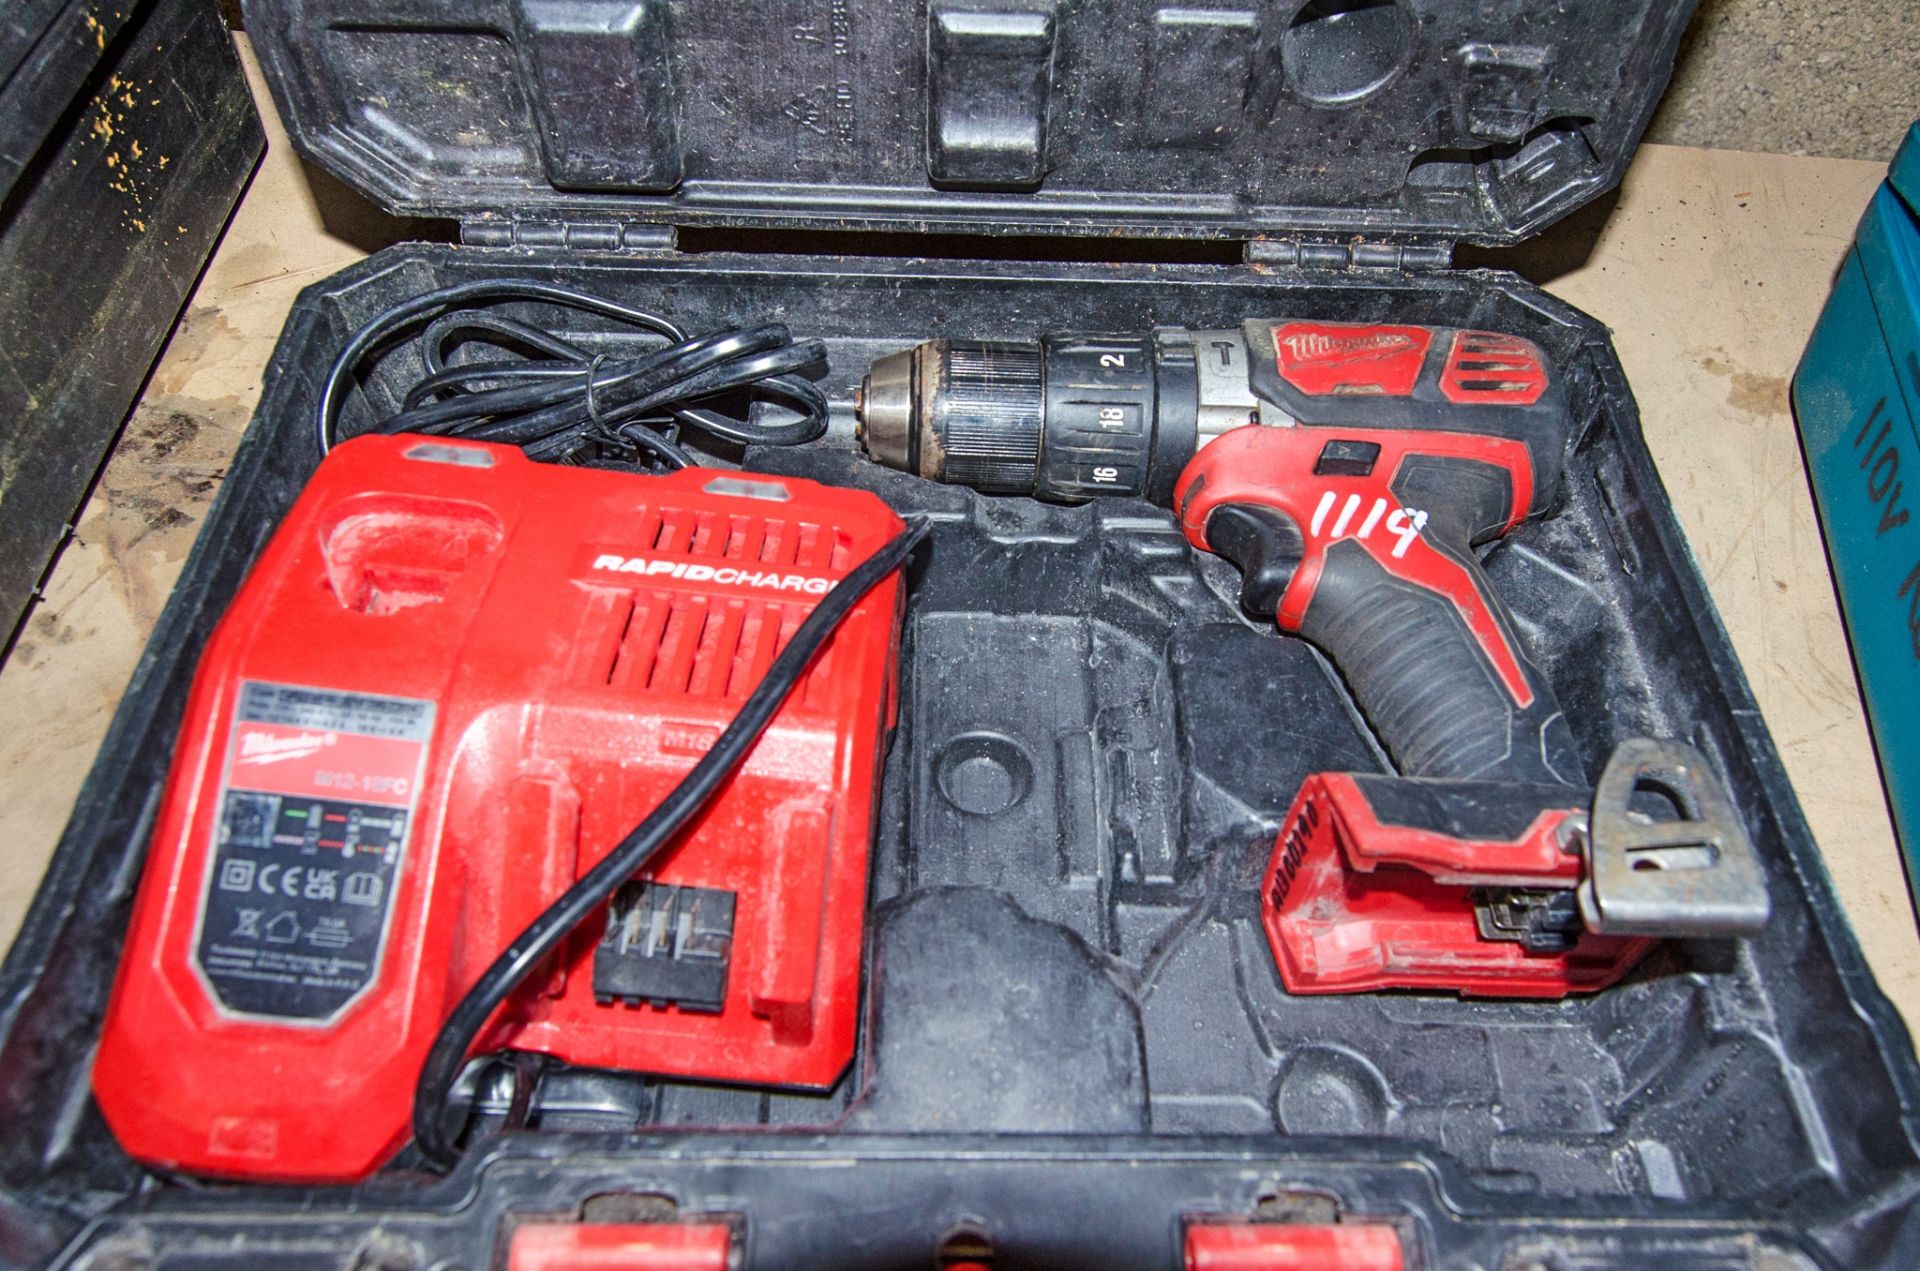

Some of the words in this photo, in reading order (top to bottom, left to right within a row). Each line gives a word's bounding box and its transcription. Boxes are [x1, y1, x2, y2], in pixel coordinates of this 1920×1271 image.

[1100, 354, 1125, 367] 2
[1099, 407, 1124, 429] 18
[1093, 467, 1118, 483] 16
[1310, 490, 1429, 559] 1119
[593, 554, 840, 595] RAPIDCHARG
